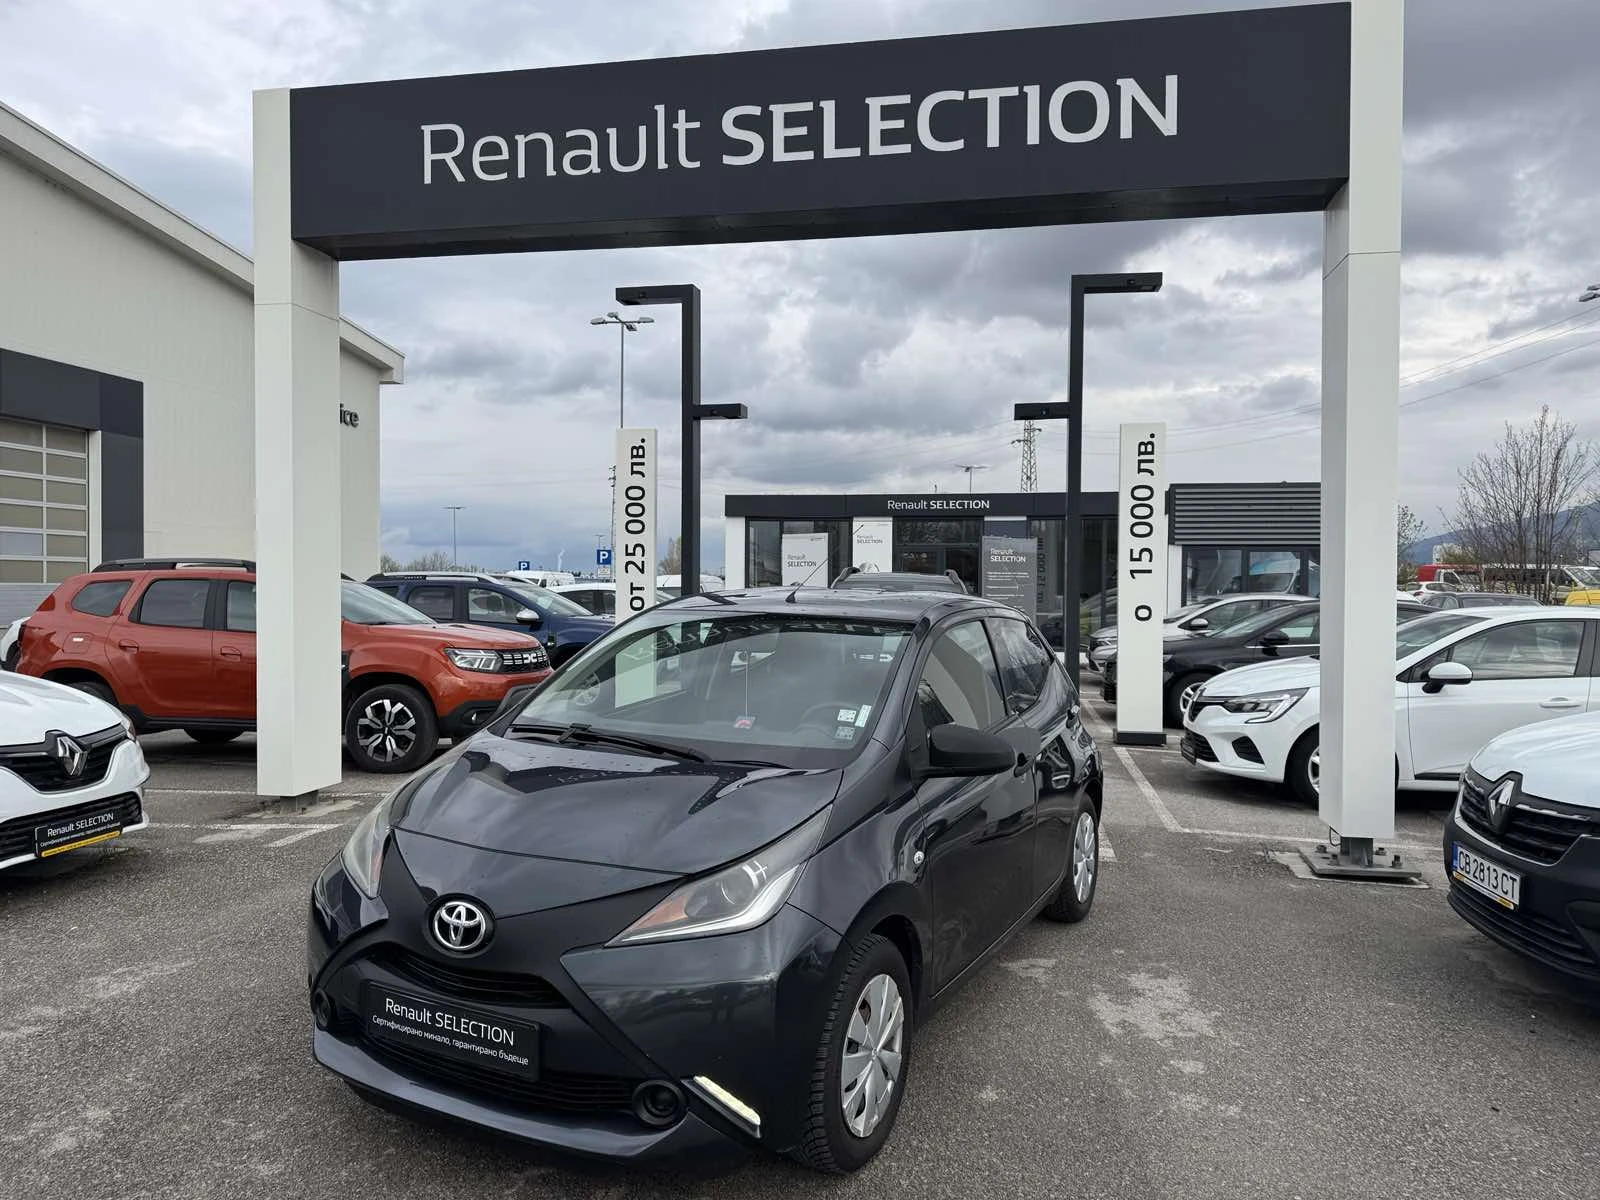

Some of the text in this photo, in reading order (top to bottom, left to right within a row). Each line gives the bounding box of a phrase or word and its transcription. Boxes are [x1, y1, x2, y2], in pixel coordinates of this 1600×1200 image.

[420, 74, 1179, 185] Renault SELECTION
[1137, 433, 1156, 477] лв.
[624, 438, 646, 612] от 25 000 лв.
[887, 499, 990, 510] Renault SELECTION
[1129, 484, 1155, 539] 000
[990, 555, 1027, 563] SELECTION
[1129, 547, 1154, 580] 15
[47, 823, 75, 838] Renault
[75, 812, 114, 831] SELECTION
[1458, 850, 1471, 875] CB
[1472, 858, 1499, 890] 2813
[1501, 872, 1518, 899] CT
[372, 1014, 529, 1066] Сертифицирано минало, гарантирано бъдеще
[385, 997, 514, 1046] Renault SELECTION
